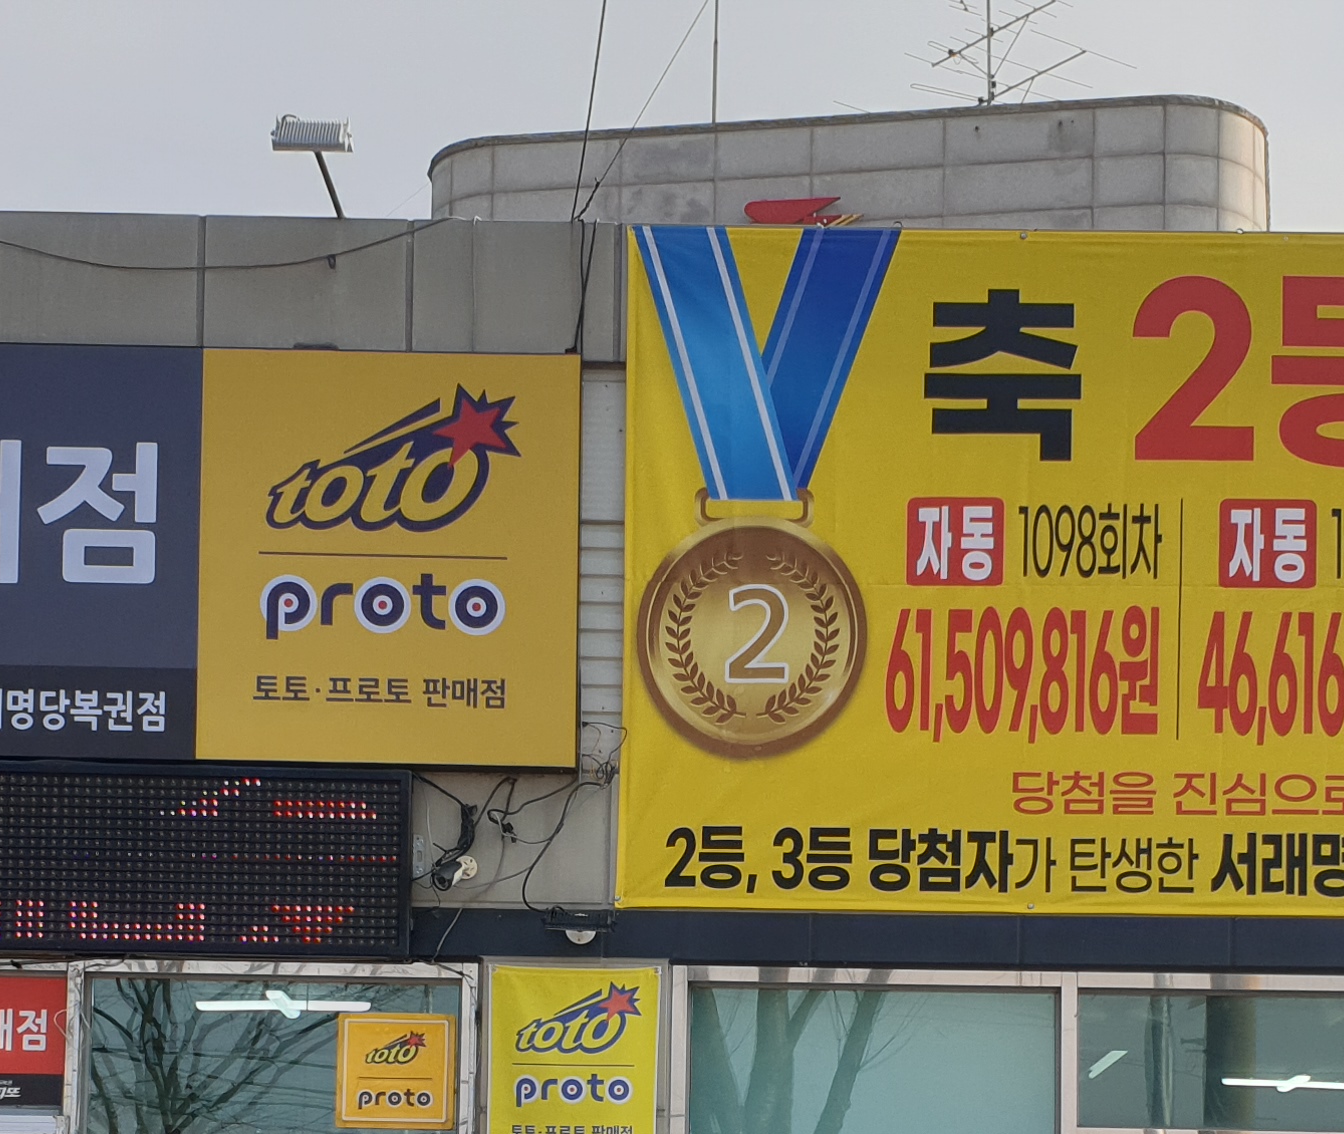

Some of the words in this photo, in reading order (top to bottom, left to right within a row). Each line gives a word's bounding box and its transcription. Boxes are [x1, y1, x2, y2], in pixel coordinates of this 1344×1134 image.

[924, 288, 1082, 461] 축
[265, 430, 496, 532] toto
[916, 504, 994, 581] 자동
[1020, 502, 1163, 580] 1098회차
[1229, 507, 1308, 584] 자동
[260, 573, 506, 640] proto
[421, 677, 508, 710] 판매점
[885, 604, 1160, 744] 61,509,816원
[1011, 770, 1157, 816] 당첨을
[664, 825, 757, 894] 2등,
[771, 826, 852, 891] 3등
[868, 828, 1056, 893] 당첨자가
[1069, 836, 1199, 895] 탄생한
[515, 1004, 630, 1055] toto
[358, 1088, 433, 1109] proto
[514, 1073, 633, 1107] proto
